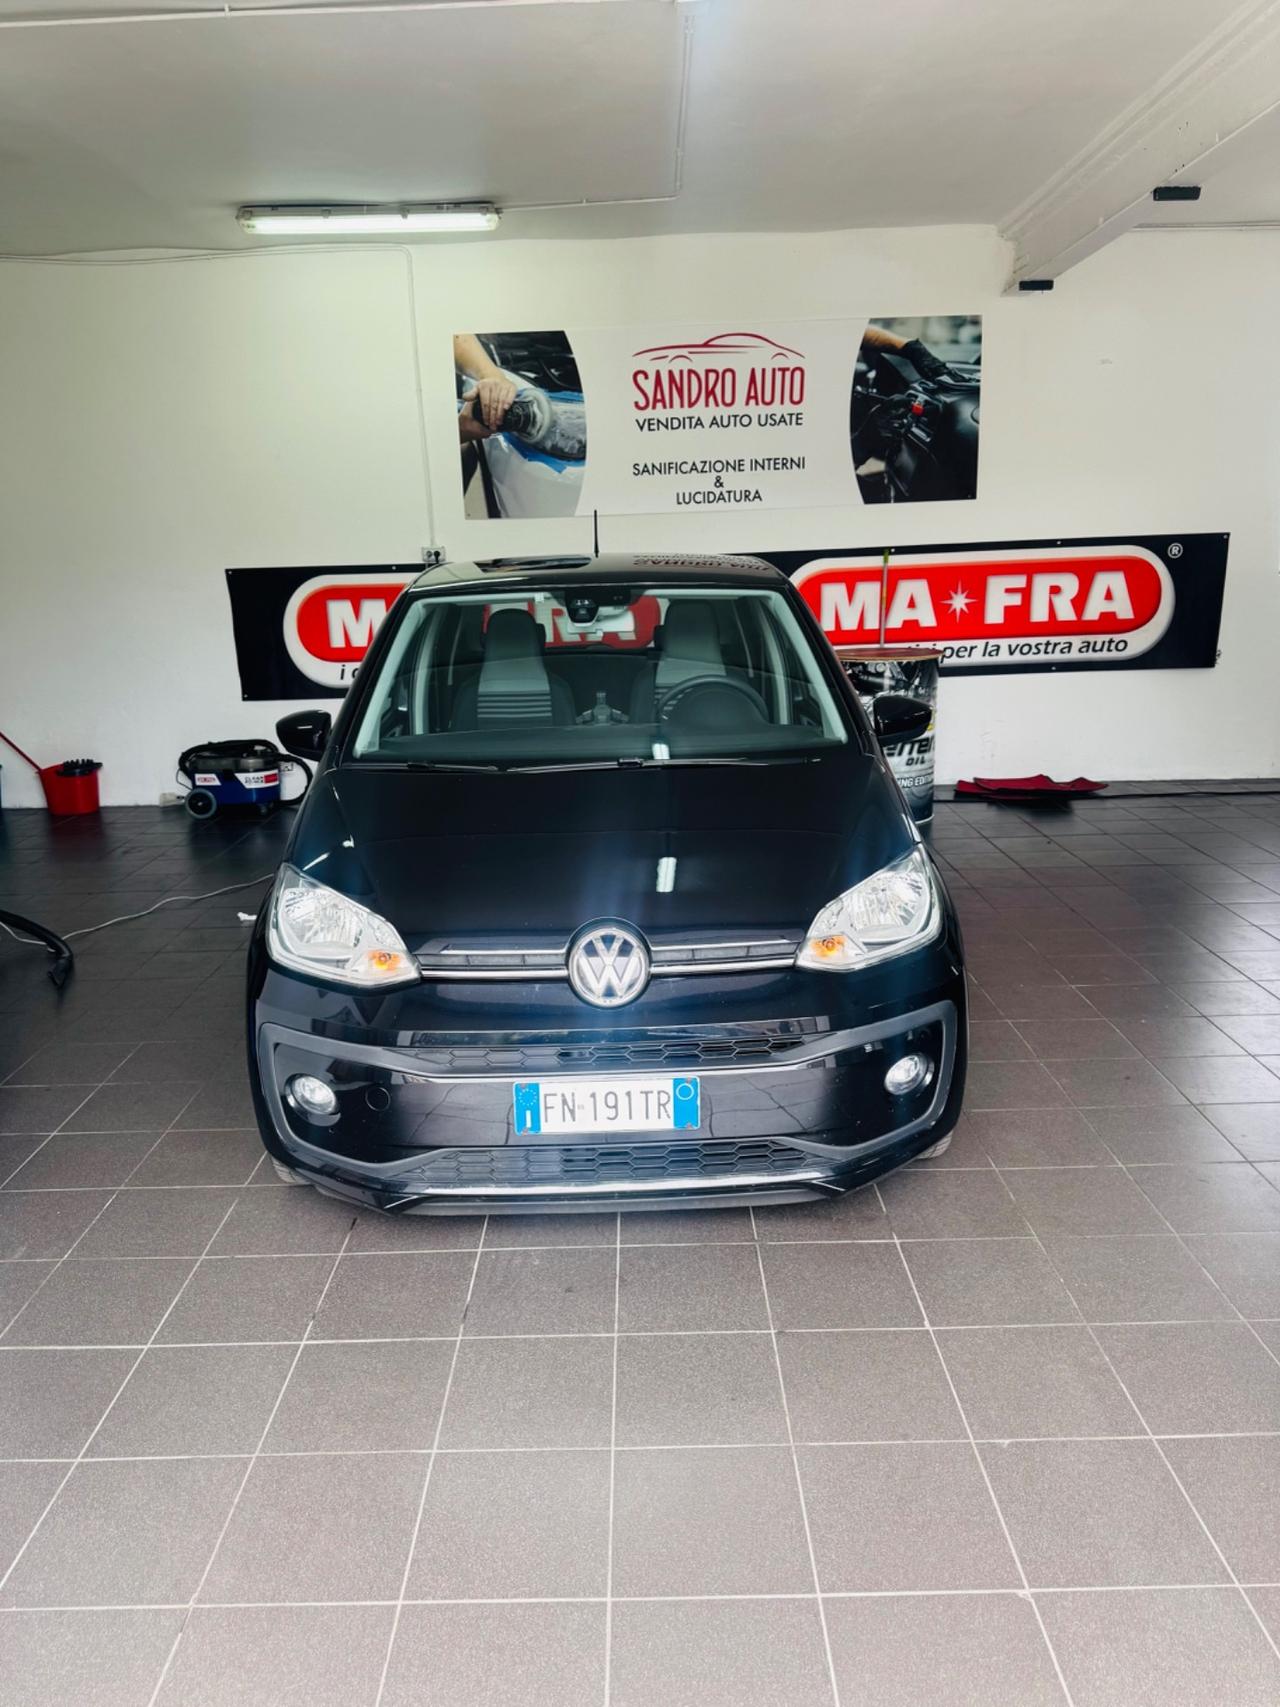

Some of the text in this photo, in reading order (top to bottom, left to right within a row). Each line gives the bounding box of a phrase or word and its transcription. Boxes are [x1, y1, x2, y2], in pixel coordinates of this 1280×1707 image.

[632, 366, 806, 411] SANDRO AUTO
[635, 412, 804, 432] VENDITA AUTO USATE
[632, 456, 806, 476] SANIFICAZIONE INTERNI
[713, 475, 724, 488] &
[675, 489, 763, 505] LUCIDATURA
[819, 570, 1136, 633] MA FRA
[940, 637, 1129, 663] per la vostra auto
[906, 756, 926, 766] OIL
